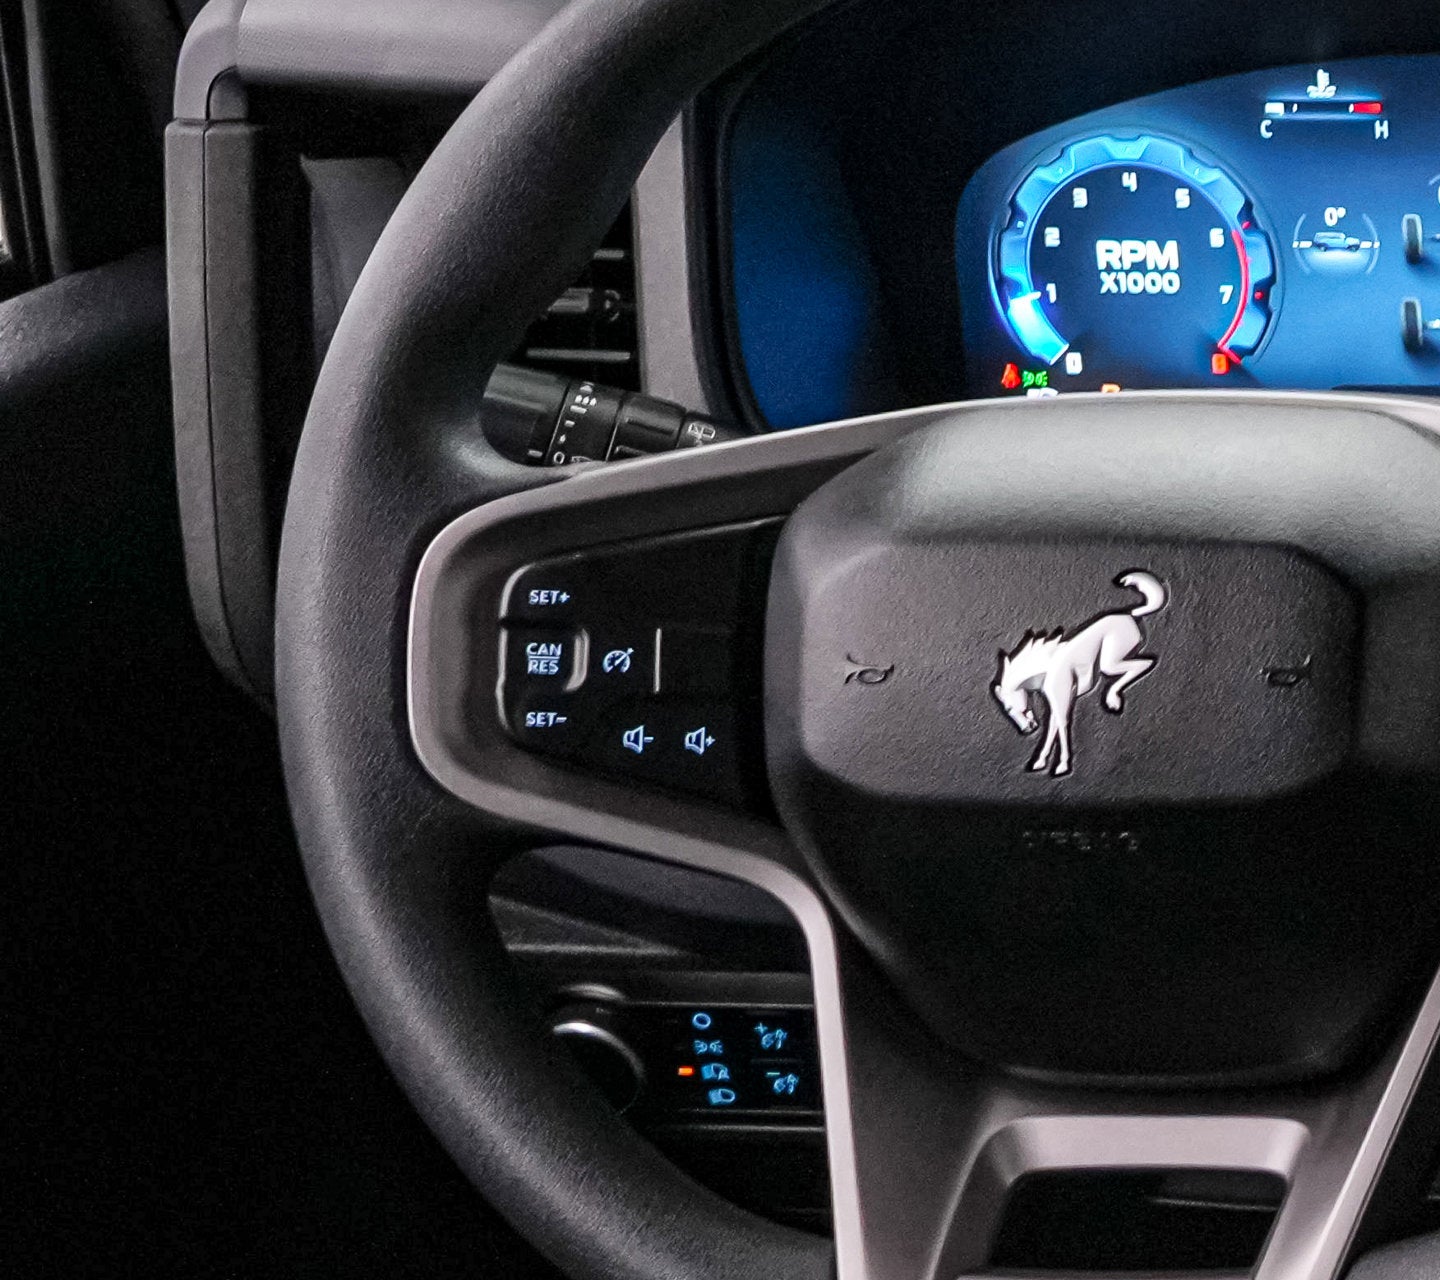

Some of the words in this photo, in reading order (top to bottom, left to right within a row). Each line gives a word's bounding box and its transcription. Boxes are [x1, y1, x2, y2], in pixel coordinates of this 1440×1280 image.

[1260, 119, 1273, 139] C
[1375, 121, 1389, 139] H
[1123, 172, 1138, 191] 4
[1073, 188, 1088, 208] 3
[1175, 188, 1190, 208] 5
[1045, 227, 1060, 247] 2
[1209, 228, 1224, 248] 6
[1096, 239, 1179, 271] RPM
[1100, 272, 1180, 294] X1000
[1046, 284, 1057, 303] 1
[1220, 285, 1233, 304] 7
[529, 589, 570, 605] SET+
[526, 643, 562, 655] CAN
[527, 660, 559, 674] RES
